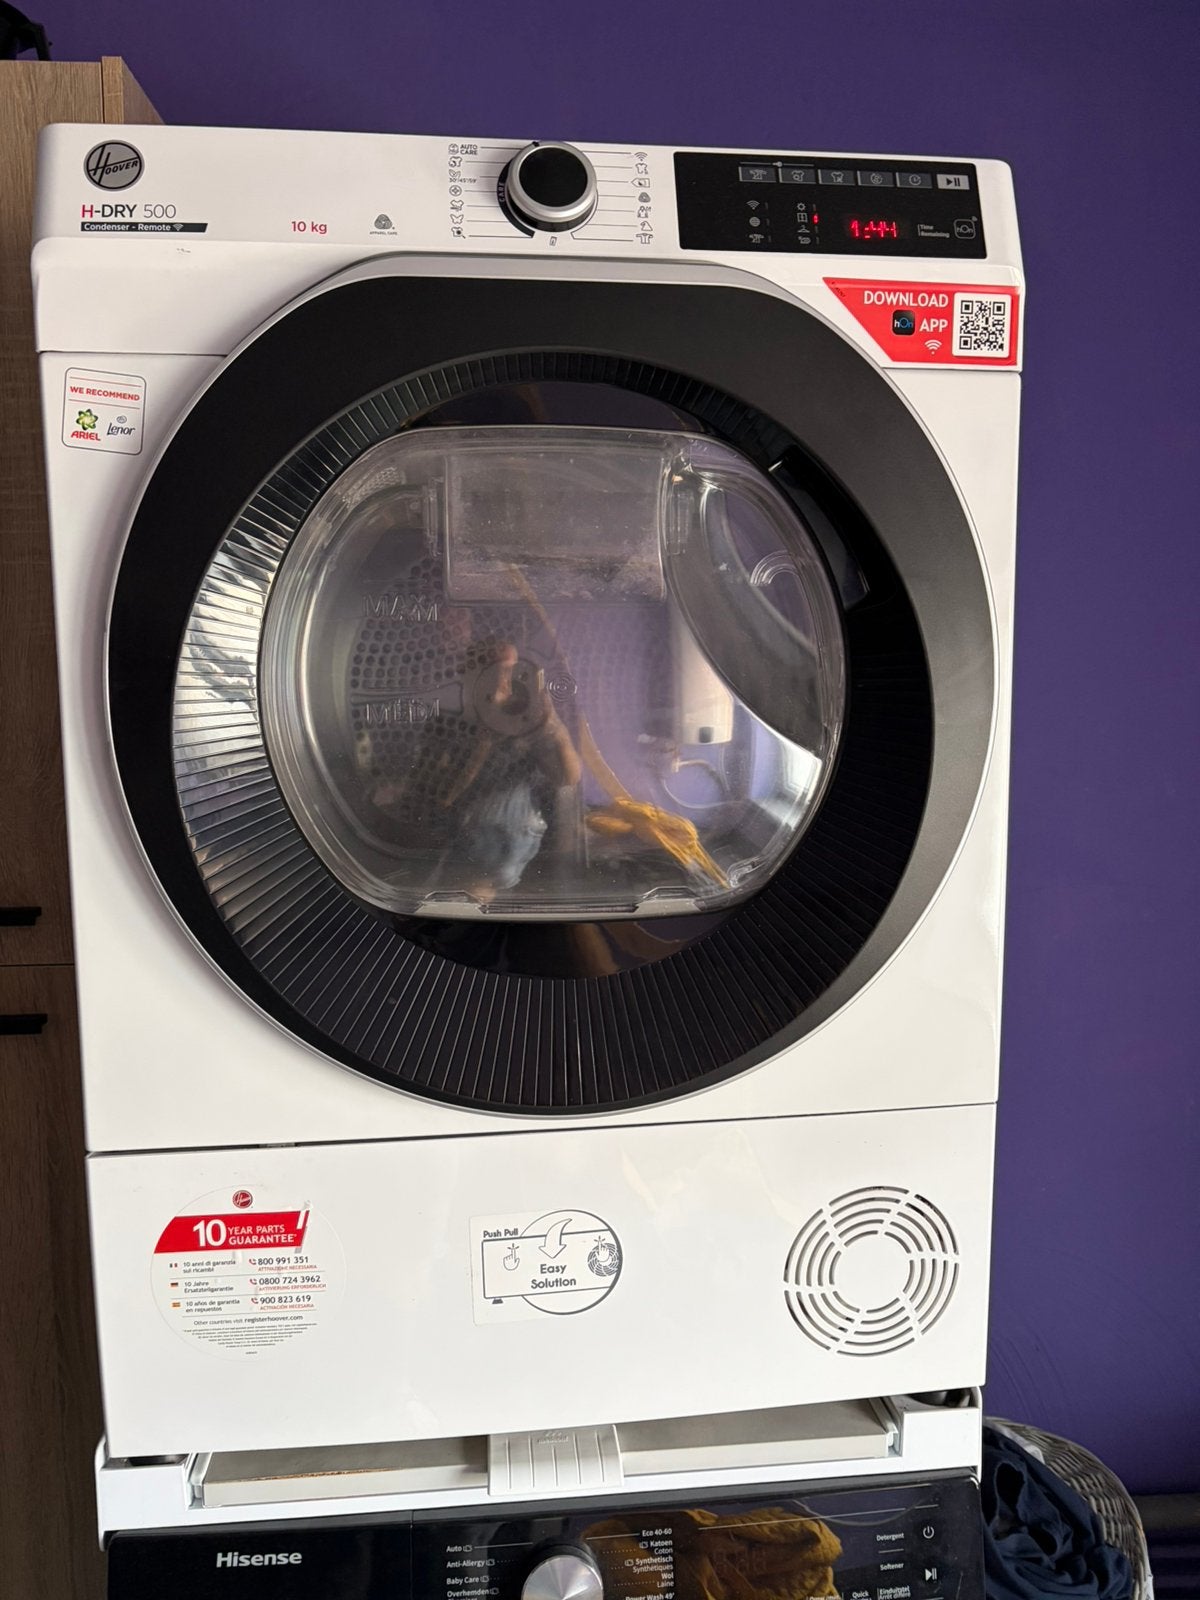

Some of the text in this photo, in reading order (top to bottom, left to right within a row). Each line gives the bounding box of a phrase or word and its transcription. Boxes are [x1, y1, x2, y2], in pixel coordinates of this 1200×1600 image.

[88, 145, 139, 184] HOOVER
[81, 204, 177, 219] H-DRY 500
[84, 223, 130, 232] Condenser
[138, 224, 171, 232] Remote
[291, 220, 328, 235] 10 kg
[863, 290, 949, 308] DOWNLOAD
[919, 318, 948, 333] APP
[69, 386, 141, 401] WE RECOMMEND
[106, 422, 136, 436] Lenor
[70, 430, 101, 441] ARIEL
[193, 1219, 286, 1247] 10 YEAR PARTS
[483, 1227, 519, 1240] Push Pull
[258, 1256, 309, 1266] 800 991 351
[540, 1263, 568, 1276] Easy
[259, 1275, 321, 1286] 0800 724 3962
[531, 1277, 577, 1290] Solution
[260, 1294, 312, 1306] 900 823 619
[244, 1315, 304, 1324] registerhoover.com
[642, 1527, 673, 1537] Eco 40-60
[876, 1533, 905, 1542] Detergent
[446, 1545, 463, 1553] Auto
[650, 1540, 673, 1548] Katoen
[654, 1547, 674, 1555] Coton
[216, 1551, 303, 1569] Hisense
[446, 1559, 486, 1569] Anti-Allergy
[635, 1555, 674, 1566] Synthetisch
[880, 1562, 905, 1571] Softener
[446, 1576, 480, 1586] Baby Care
[661, 1572, 675, 1580] Wol
[656, 1580, 675, 1588] Laine
[446, 1588, 490, 1598] Overhemden
[852, 1590, 870, 1598] Quick
